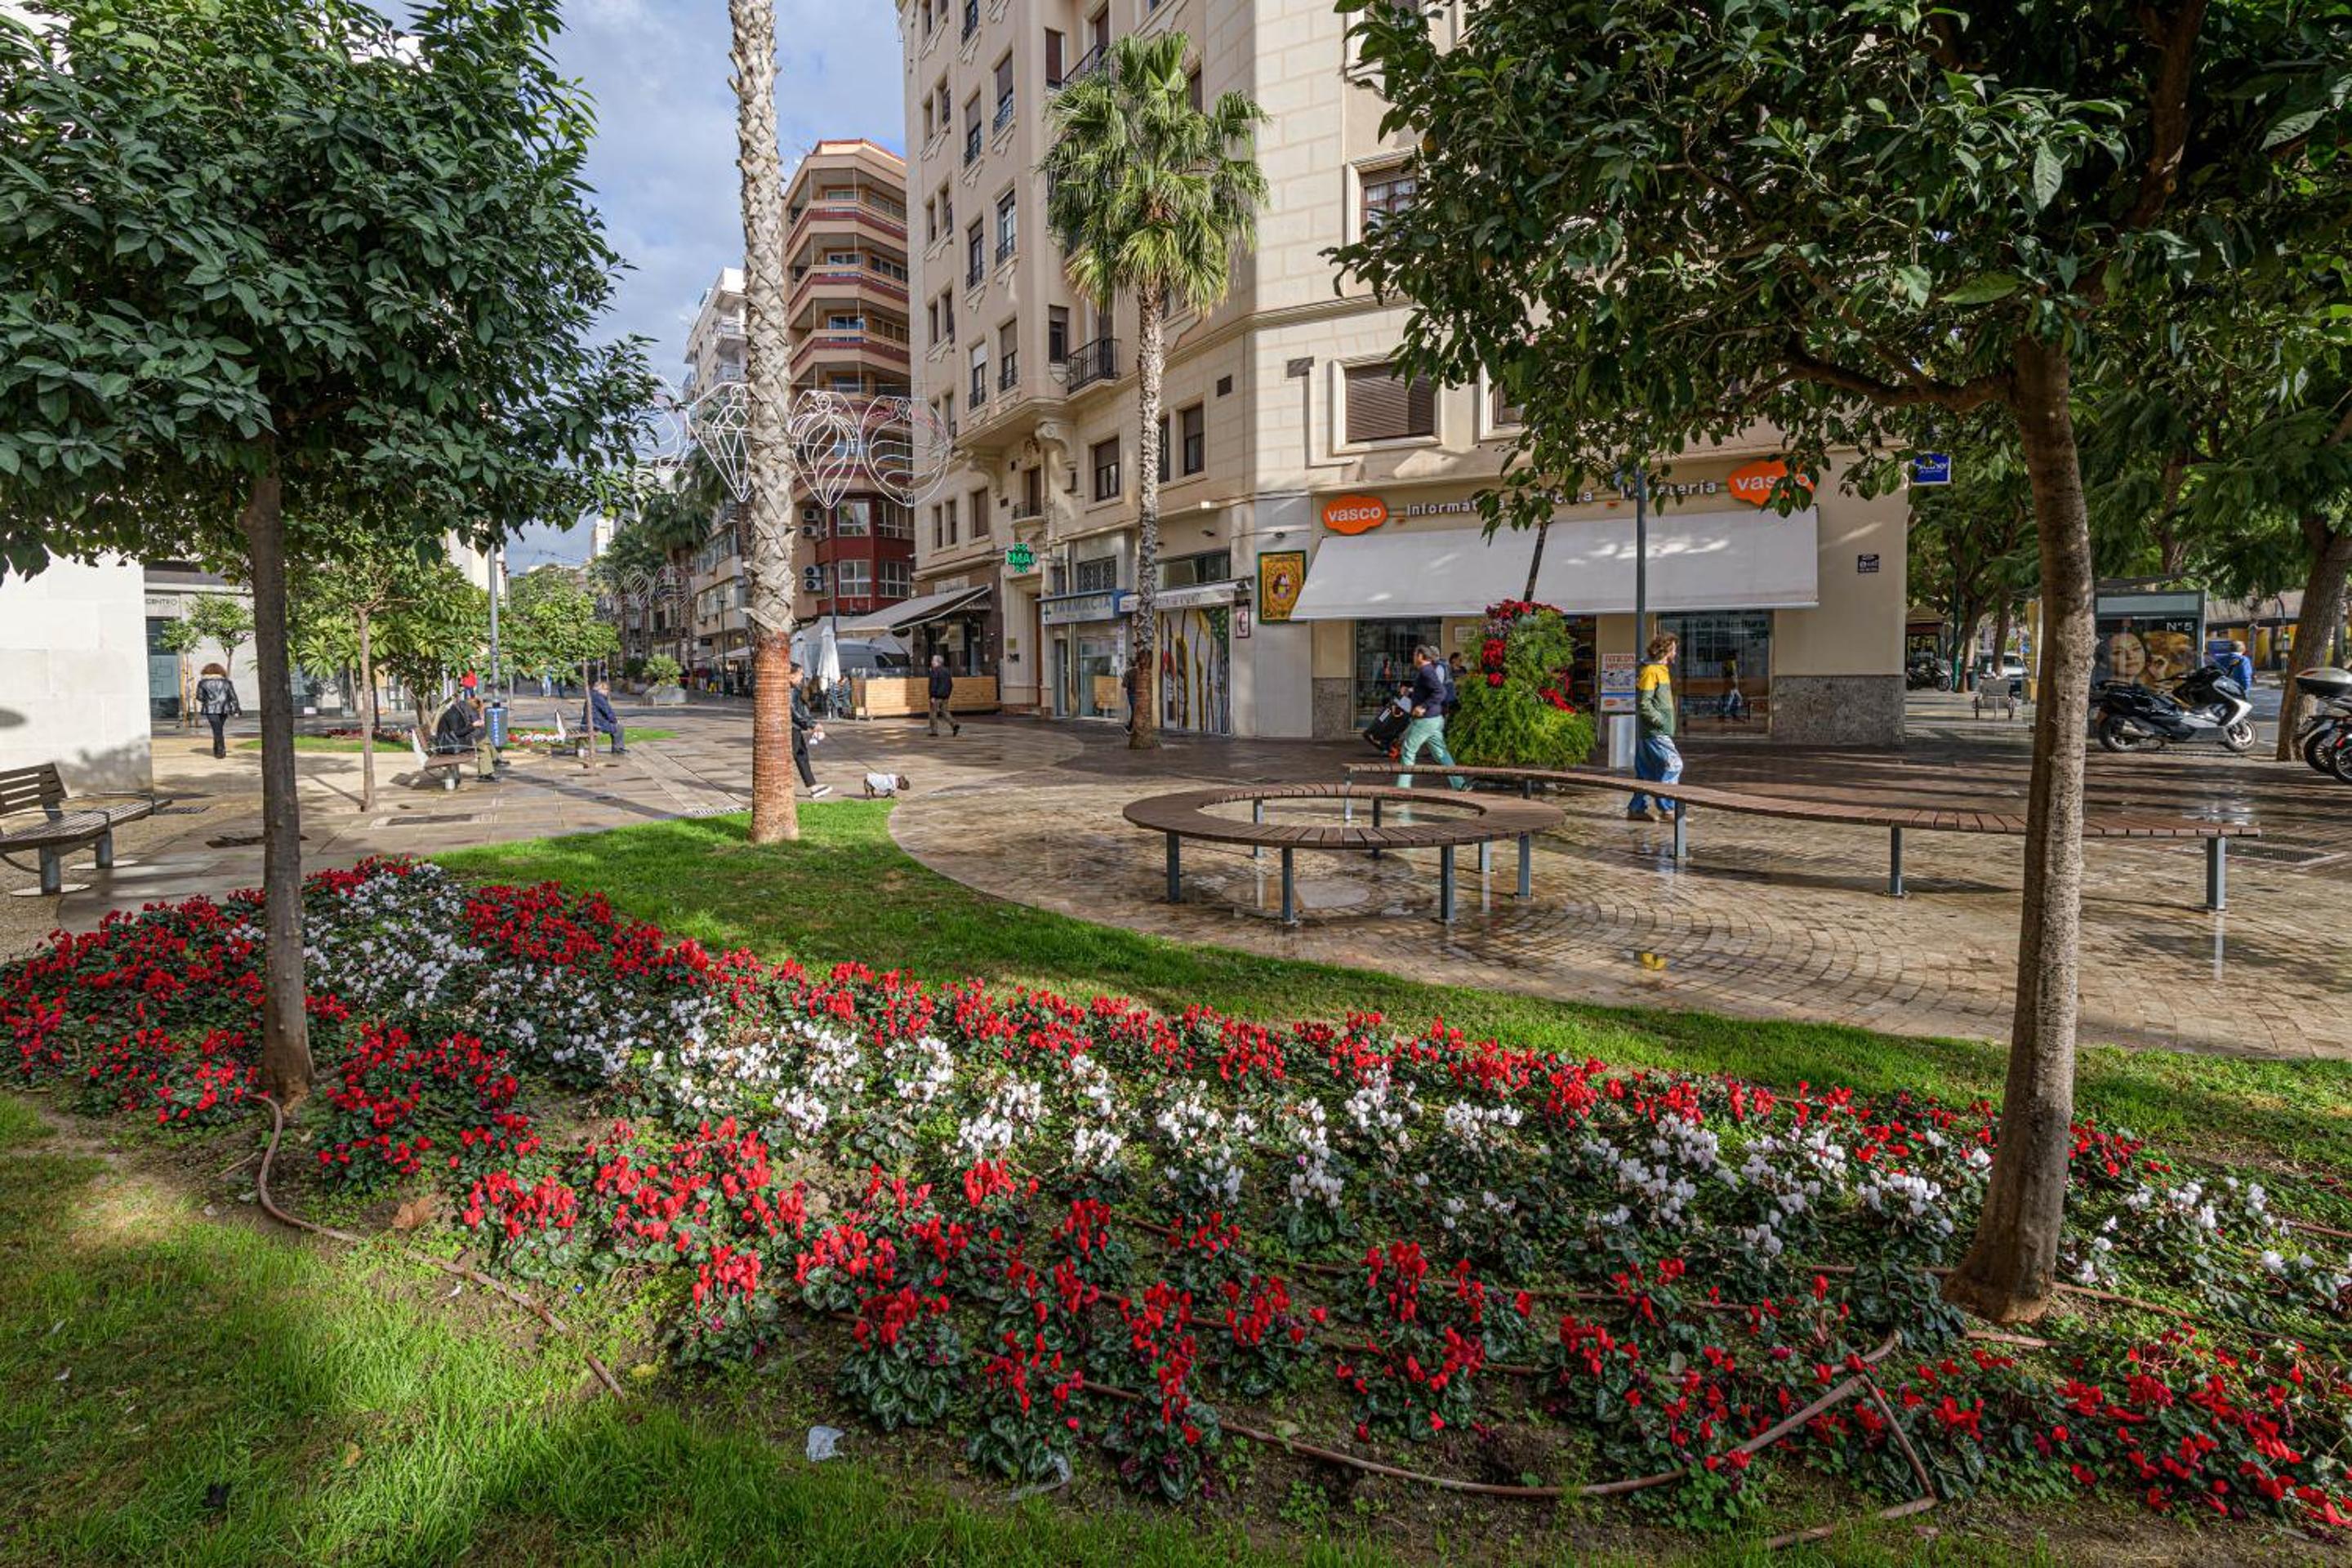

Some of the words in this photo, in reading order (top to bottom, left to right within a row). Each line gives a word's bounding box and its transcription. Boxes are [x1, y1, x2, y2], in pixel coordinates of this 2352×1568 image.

[1735, 474, 1810, 491] vaso
[1328, 506, 1381, 523] vasco
[1407, 498, 1505, 516] Informáta
[1053, 595, 1111, 613] FARMACIA
